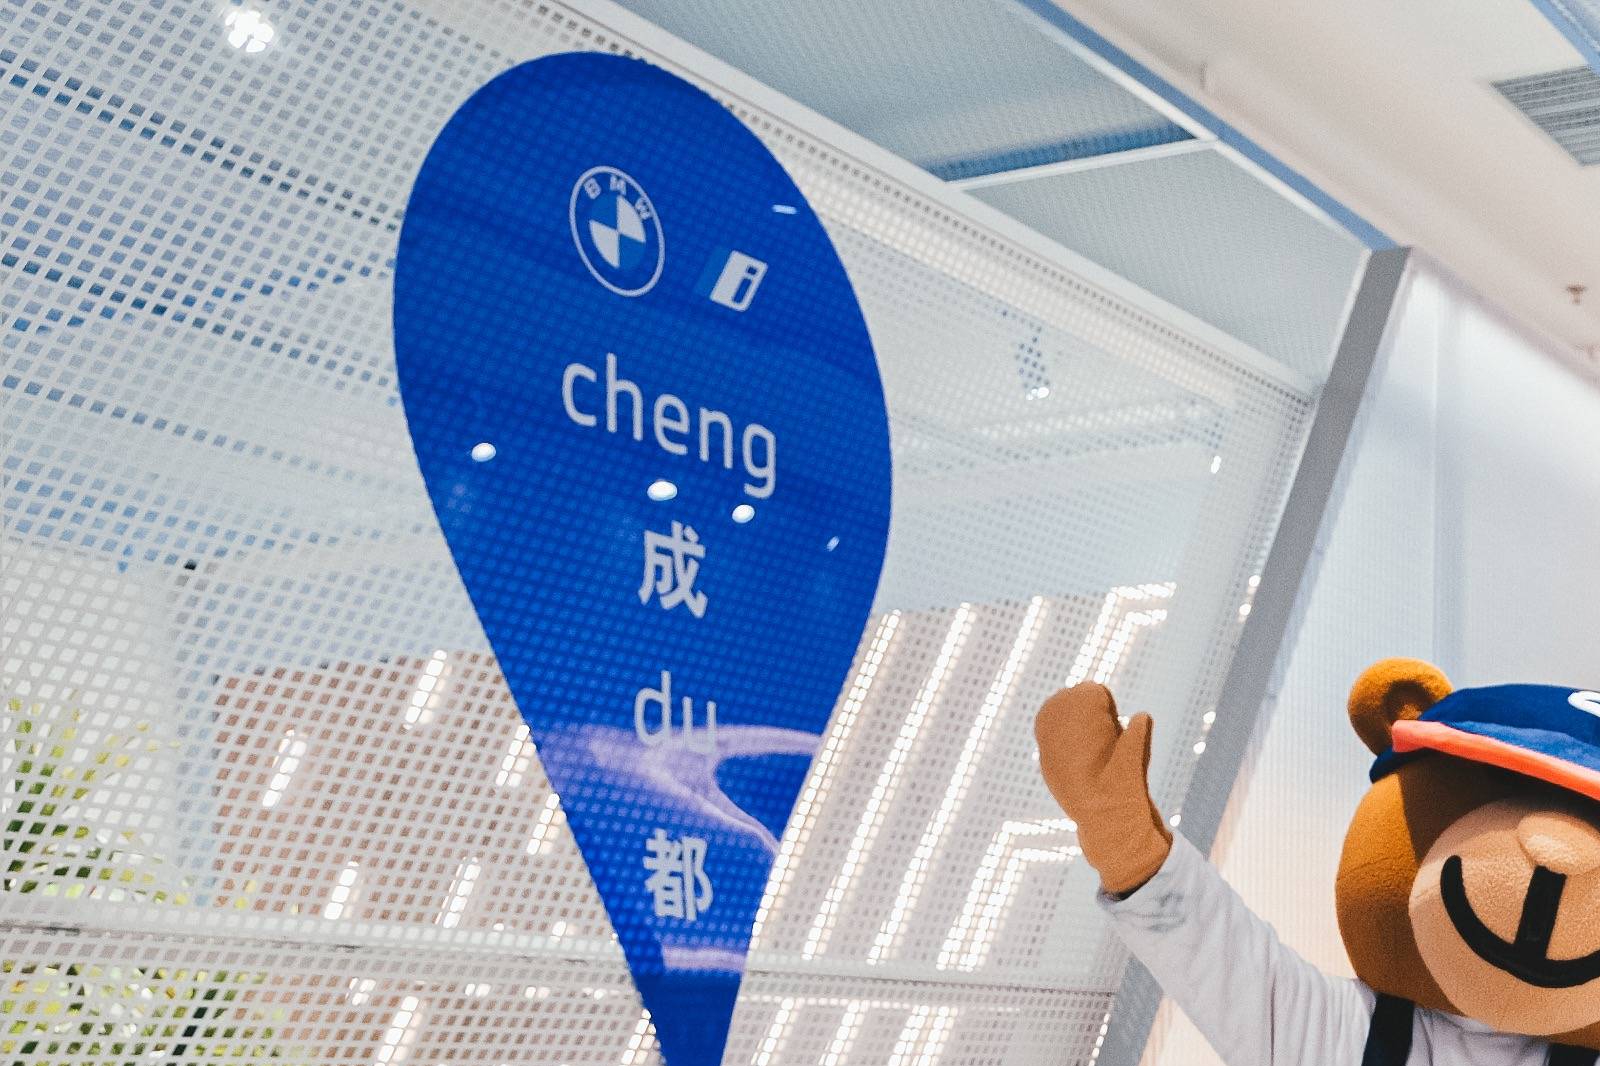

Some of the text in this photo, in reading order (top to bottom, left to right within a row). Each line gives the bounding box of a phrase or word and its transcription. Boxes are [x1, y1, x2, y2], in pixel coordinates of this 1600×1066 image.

[562, 352, 777, 499] cheng
[637, 520, 709, 619] 成
[634, 670, 717, 755] du
[643, 828, 714, 921] 都
